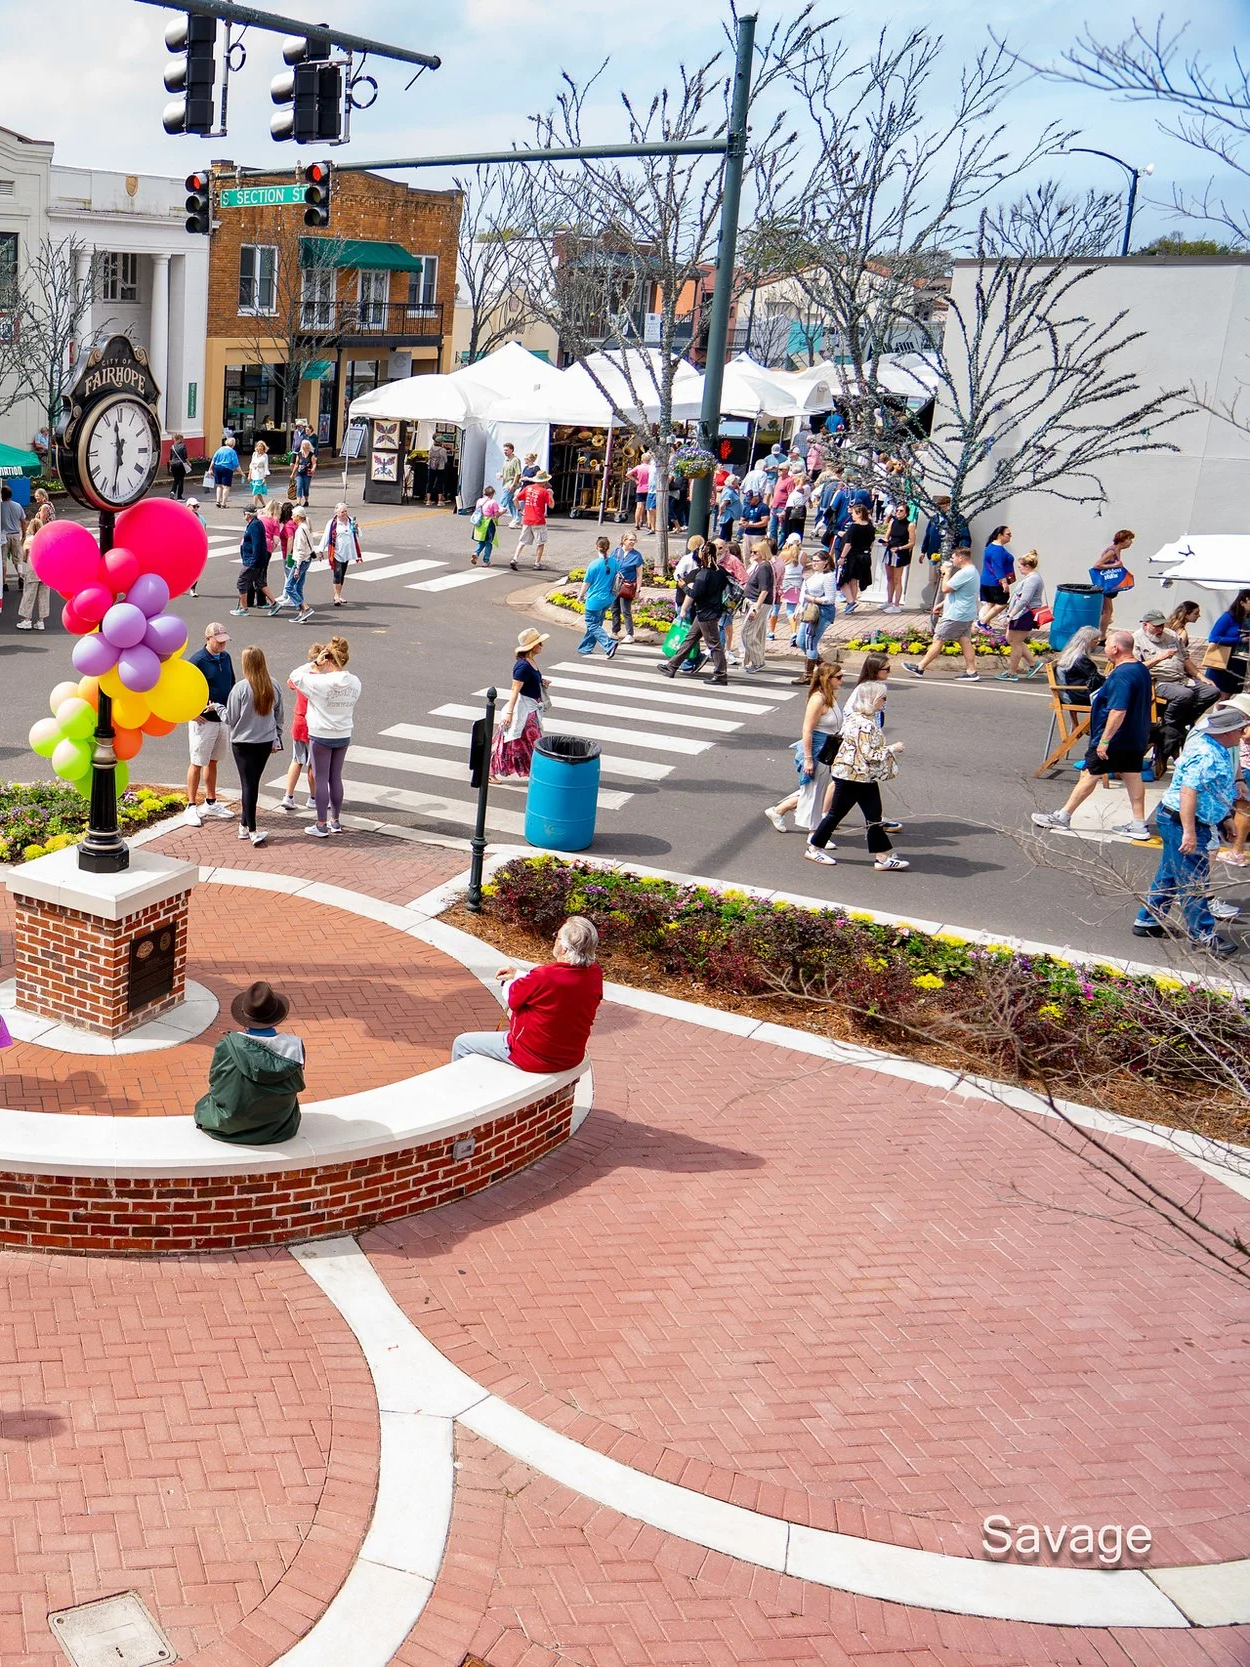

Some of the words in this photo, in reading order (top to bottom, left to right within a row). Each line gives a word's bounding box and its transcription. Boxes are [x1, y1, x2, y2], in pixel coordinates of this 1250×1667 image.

[222, 192, 230, 206] S
[237, 189, 285, 205] SECTION
[101, 357, 118, 366] CITY
[122, 357, 132, 365] OF
[85, 366, 146, 398] FAIRHOPE
